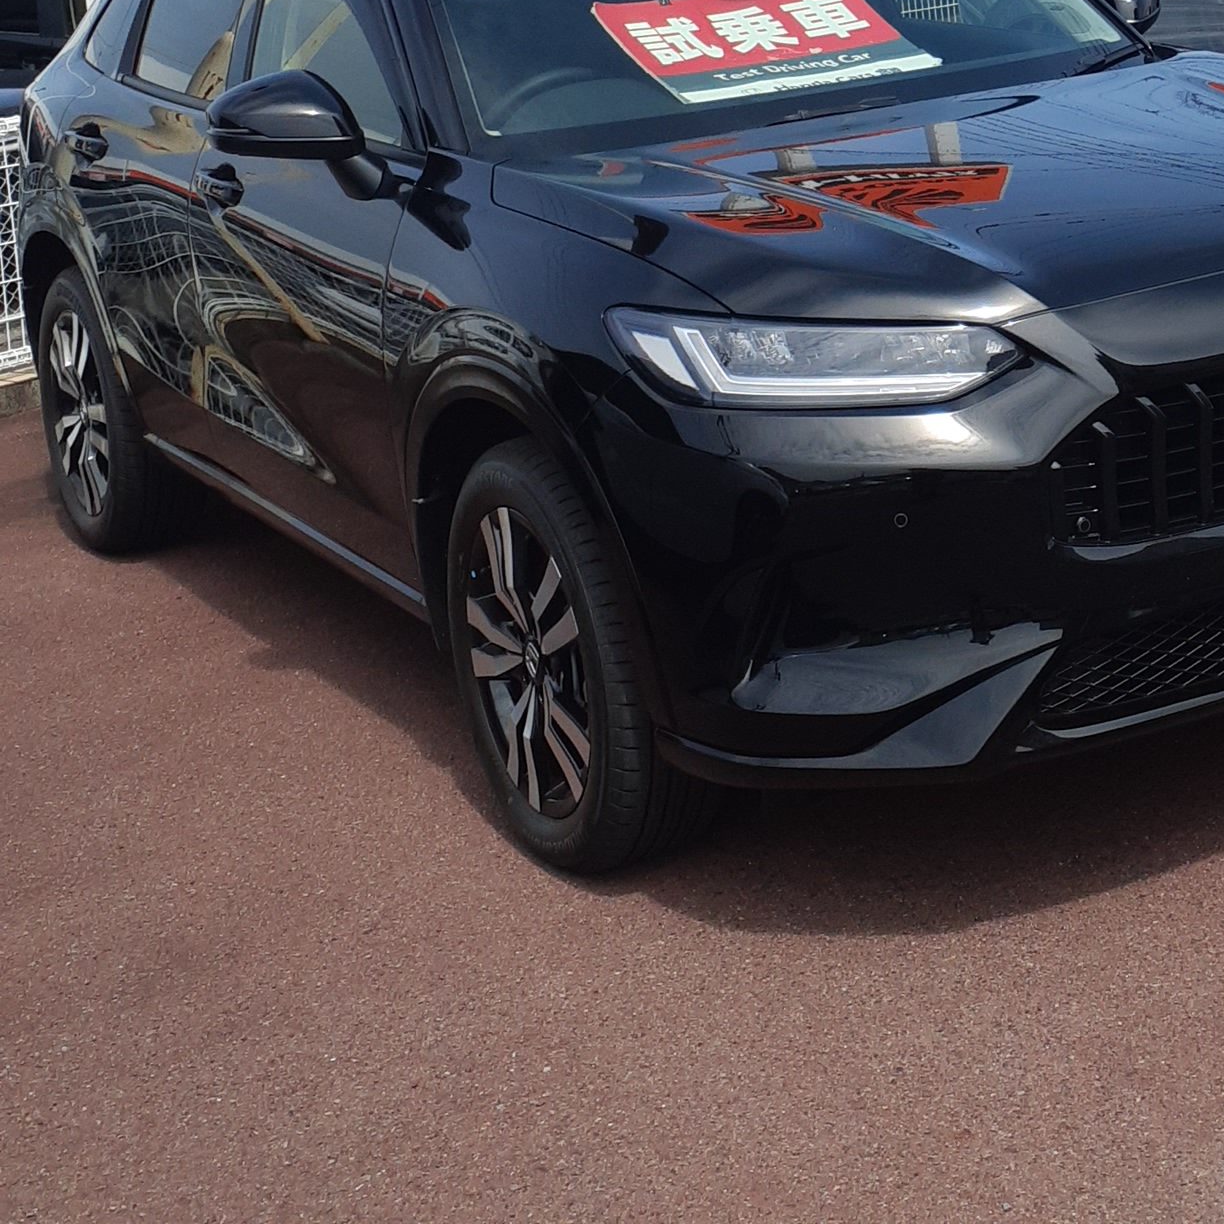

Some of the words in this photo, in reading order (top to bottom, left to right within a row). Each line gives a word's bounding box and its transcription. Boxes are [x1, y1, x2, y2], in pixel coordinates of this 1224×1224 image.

[713, 68, 759, 82] Test
[762, 55, 838, 74] Driving
[838, 51, 872, 65] Car
